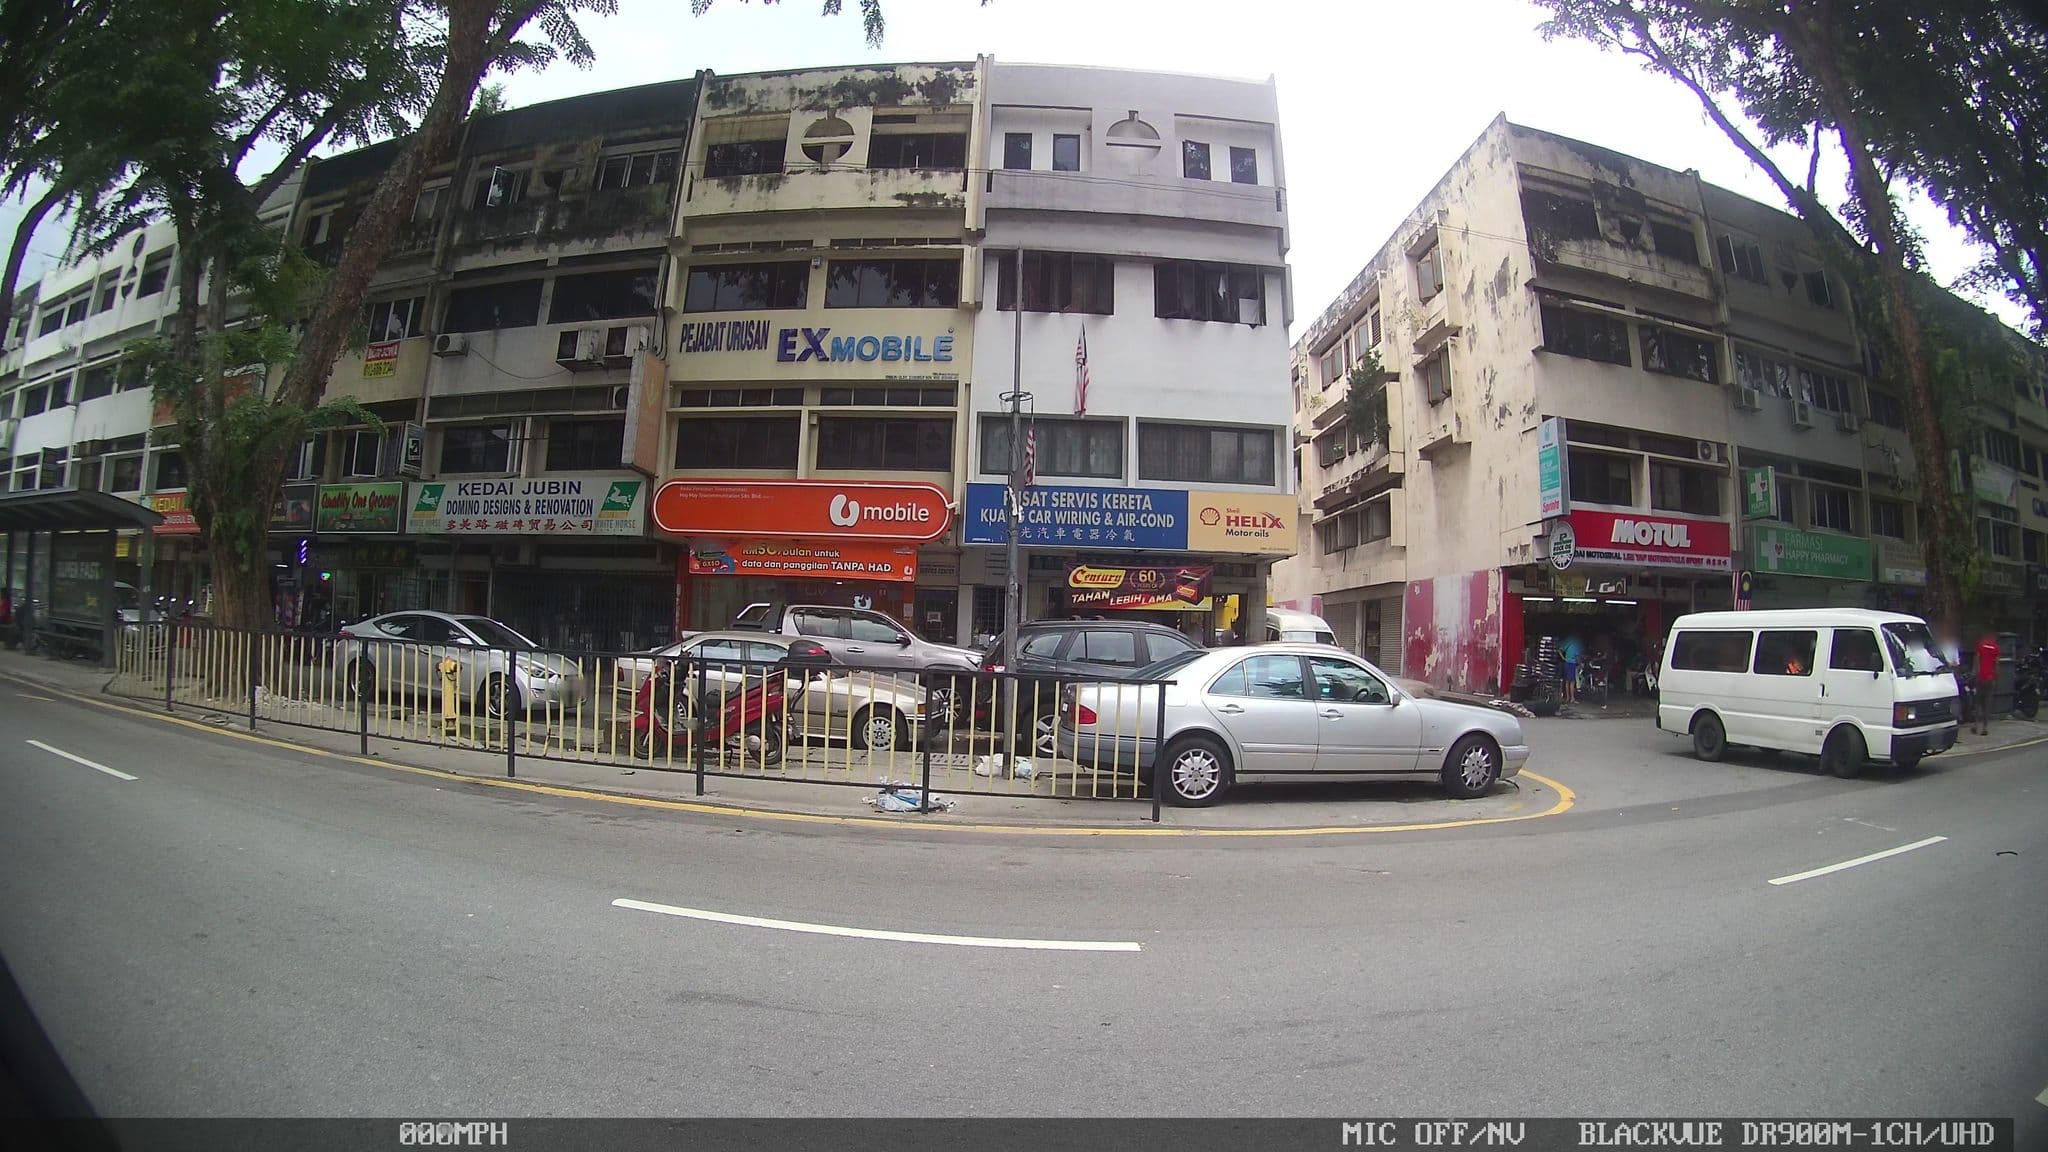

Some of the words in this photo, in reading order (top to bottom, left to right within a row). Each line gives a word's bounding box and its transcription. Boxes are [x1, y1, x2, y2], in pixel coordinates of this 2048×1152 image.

[680, 323, 726, 353] PEJABAT
[727, 320, 770, 351] URUSAN
[458, 482, 513, 496] KEDAI
[521, 481, 581, 495] JUBIN
[446, 500, 480, 515] DOMINO
[483, 500, 521, 515] DESIGNS
[523, 500, 532, 515] &
[534, 499, 594, 515] RENOVATION
[1003, 490, 1047, 507] PSAT
[1051, 491, 1098, 509] SERVIS
[1102, 493, 1153, 511] KERETA
[863, 502, 929, 522] mobile
[1028, 511, 1051, 524] CAR
[1055, 511, 1101, 526] WIRING
[1104, 512, 1113, 526] &
[1116, 513, 1175, 528] AIR-COND
[1226, 513, 1285, 529] HELIX
[1225, 528, 1253, 538] Motor
[1254, 529, 1270, 538] oils
[1611, 519, 1691, 547] MOTUL
[814, 549, 840, 558] untuk
[741, 560, 762, 568] data
[764, 560, 781, 568] dan
[783, 560, 829, 571] panggilan
[831, 561, 865, 571] TANPA
[868, 563, 894, 573] HAD.
[1072, 568, 1122, 584] Century
[1138, 570, 1156, 583] 60
[1072, 590, 1110, 603] TAHAN
[1109, 594, 1142, 606] LEBIH
[1142, 593, 1173, 605] LAMA
